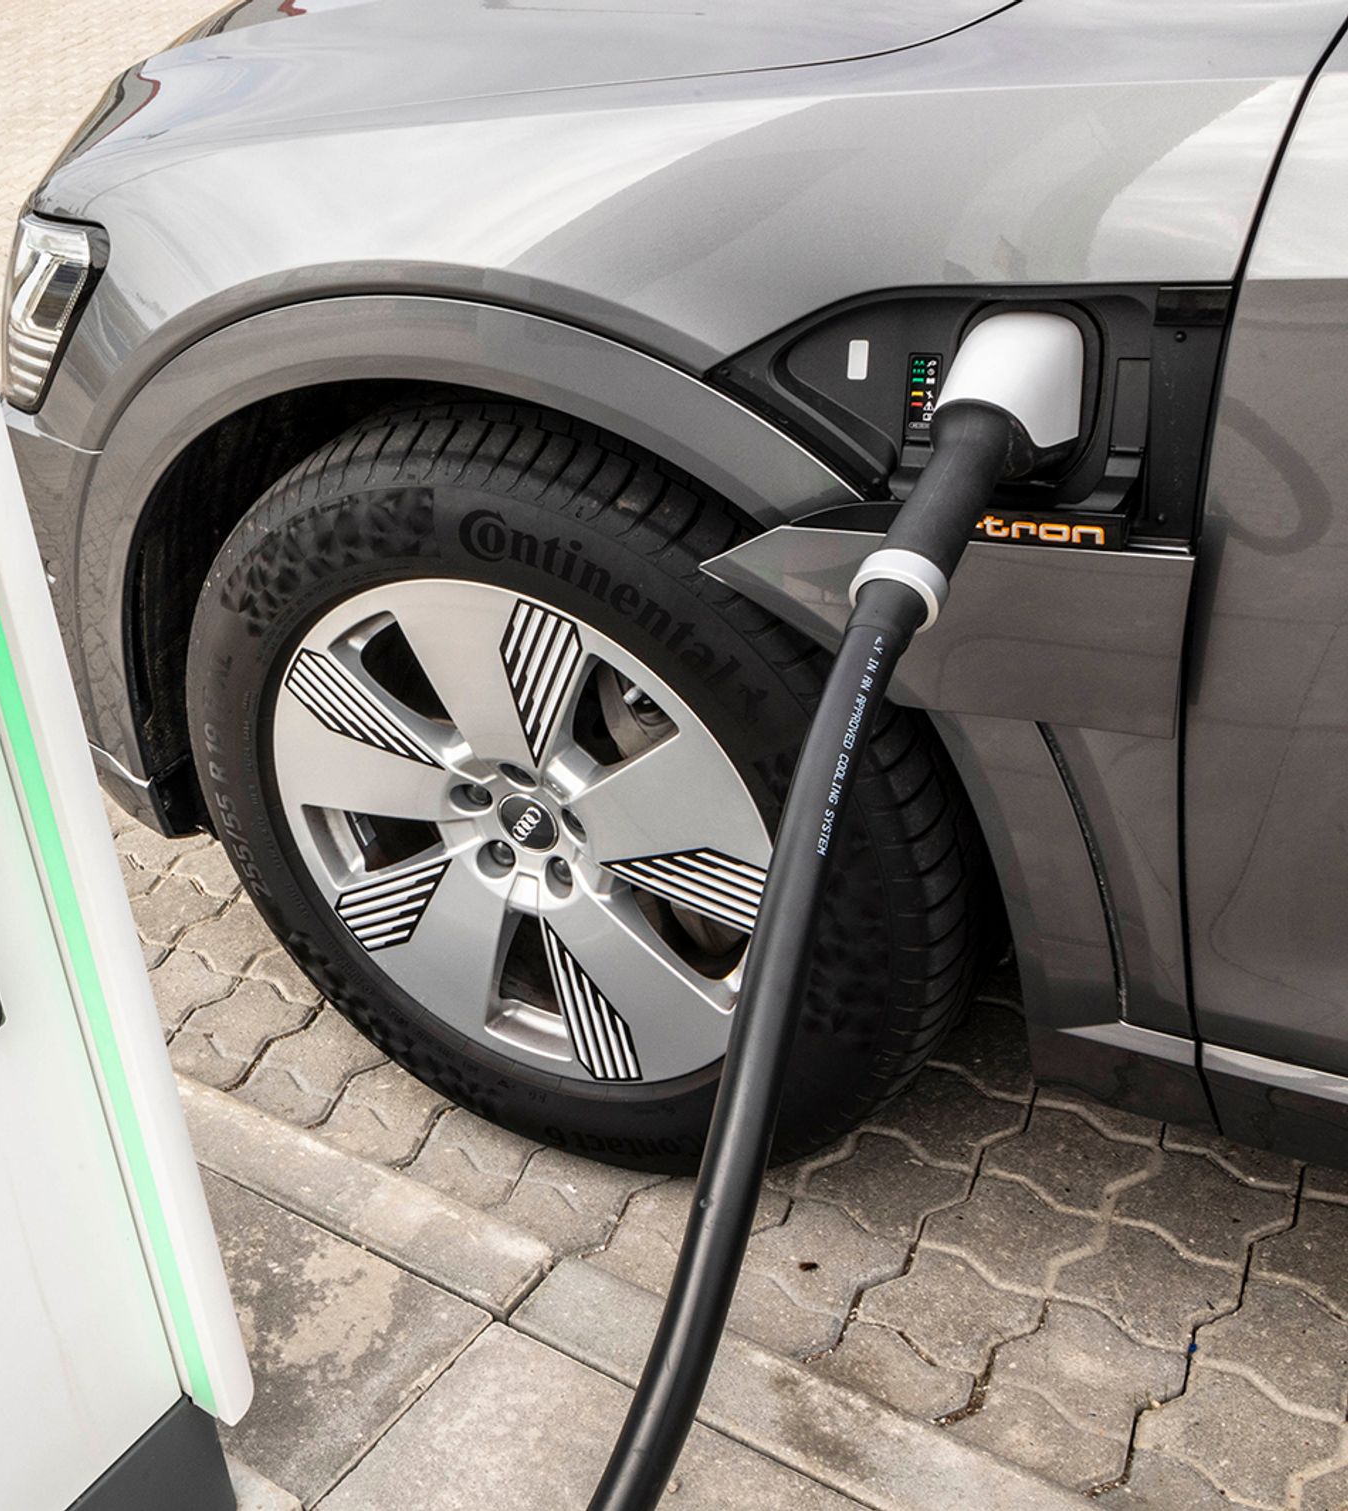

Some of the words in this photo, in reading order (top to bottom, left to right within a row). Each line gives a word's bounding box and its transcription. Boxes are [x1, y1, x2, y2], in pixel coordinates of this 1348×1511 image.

[458, 508, 742, 682] Continental
[860, 674, 873, 691] AN
[866, 657, 879, 673] IN
[842, 692, 868, 751] APPROVED
[828, 753, 850, 806] COOLING
[214, 796, 273, 899] 255/55
[816, 808, 836, 857] SYSTEM
